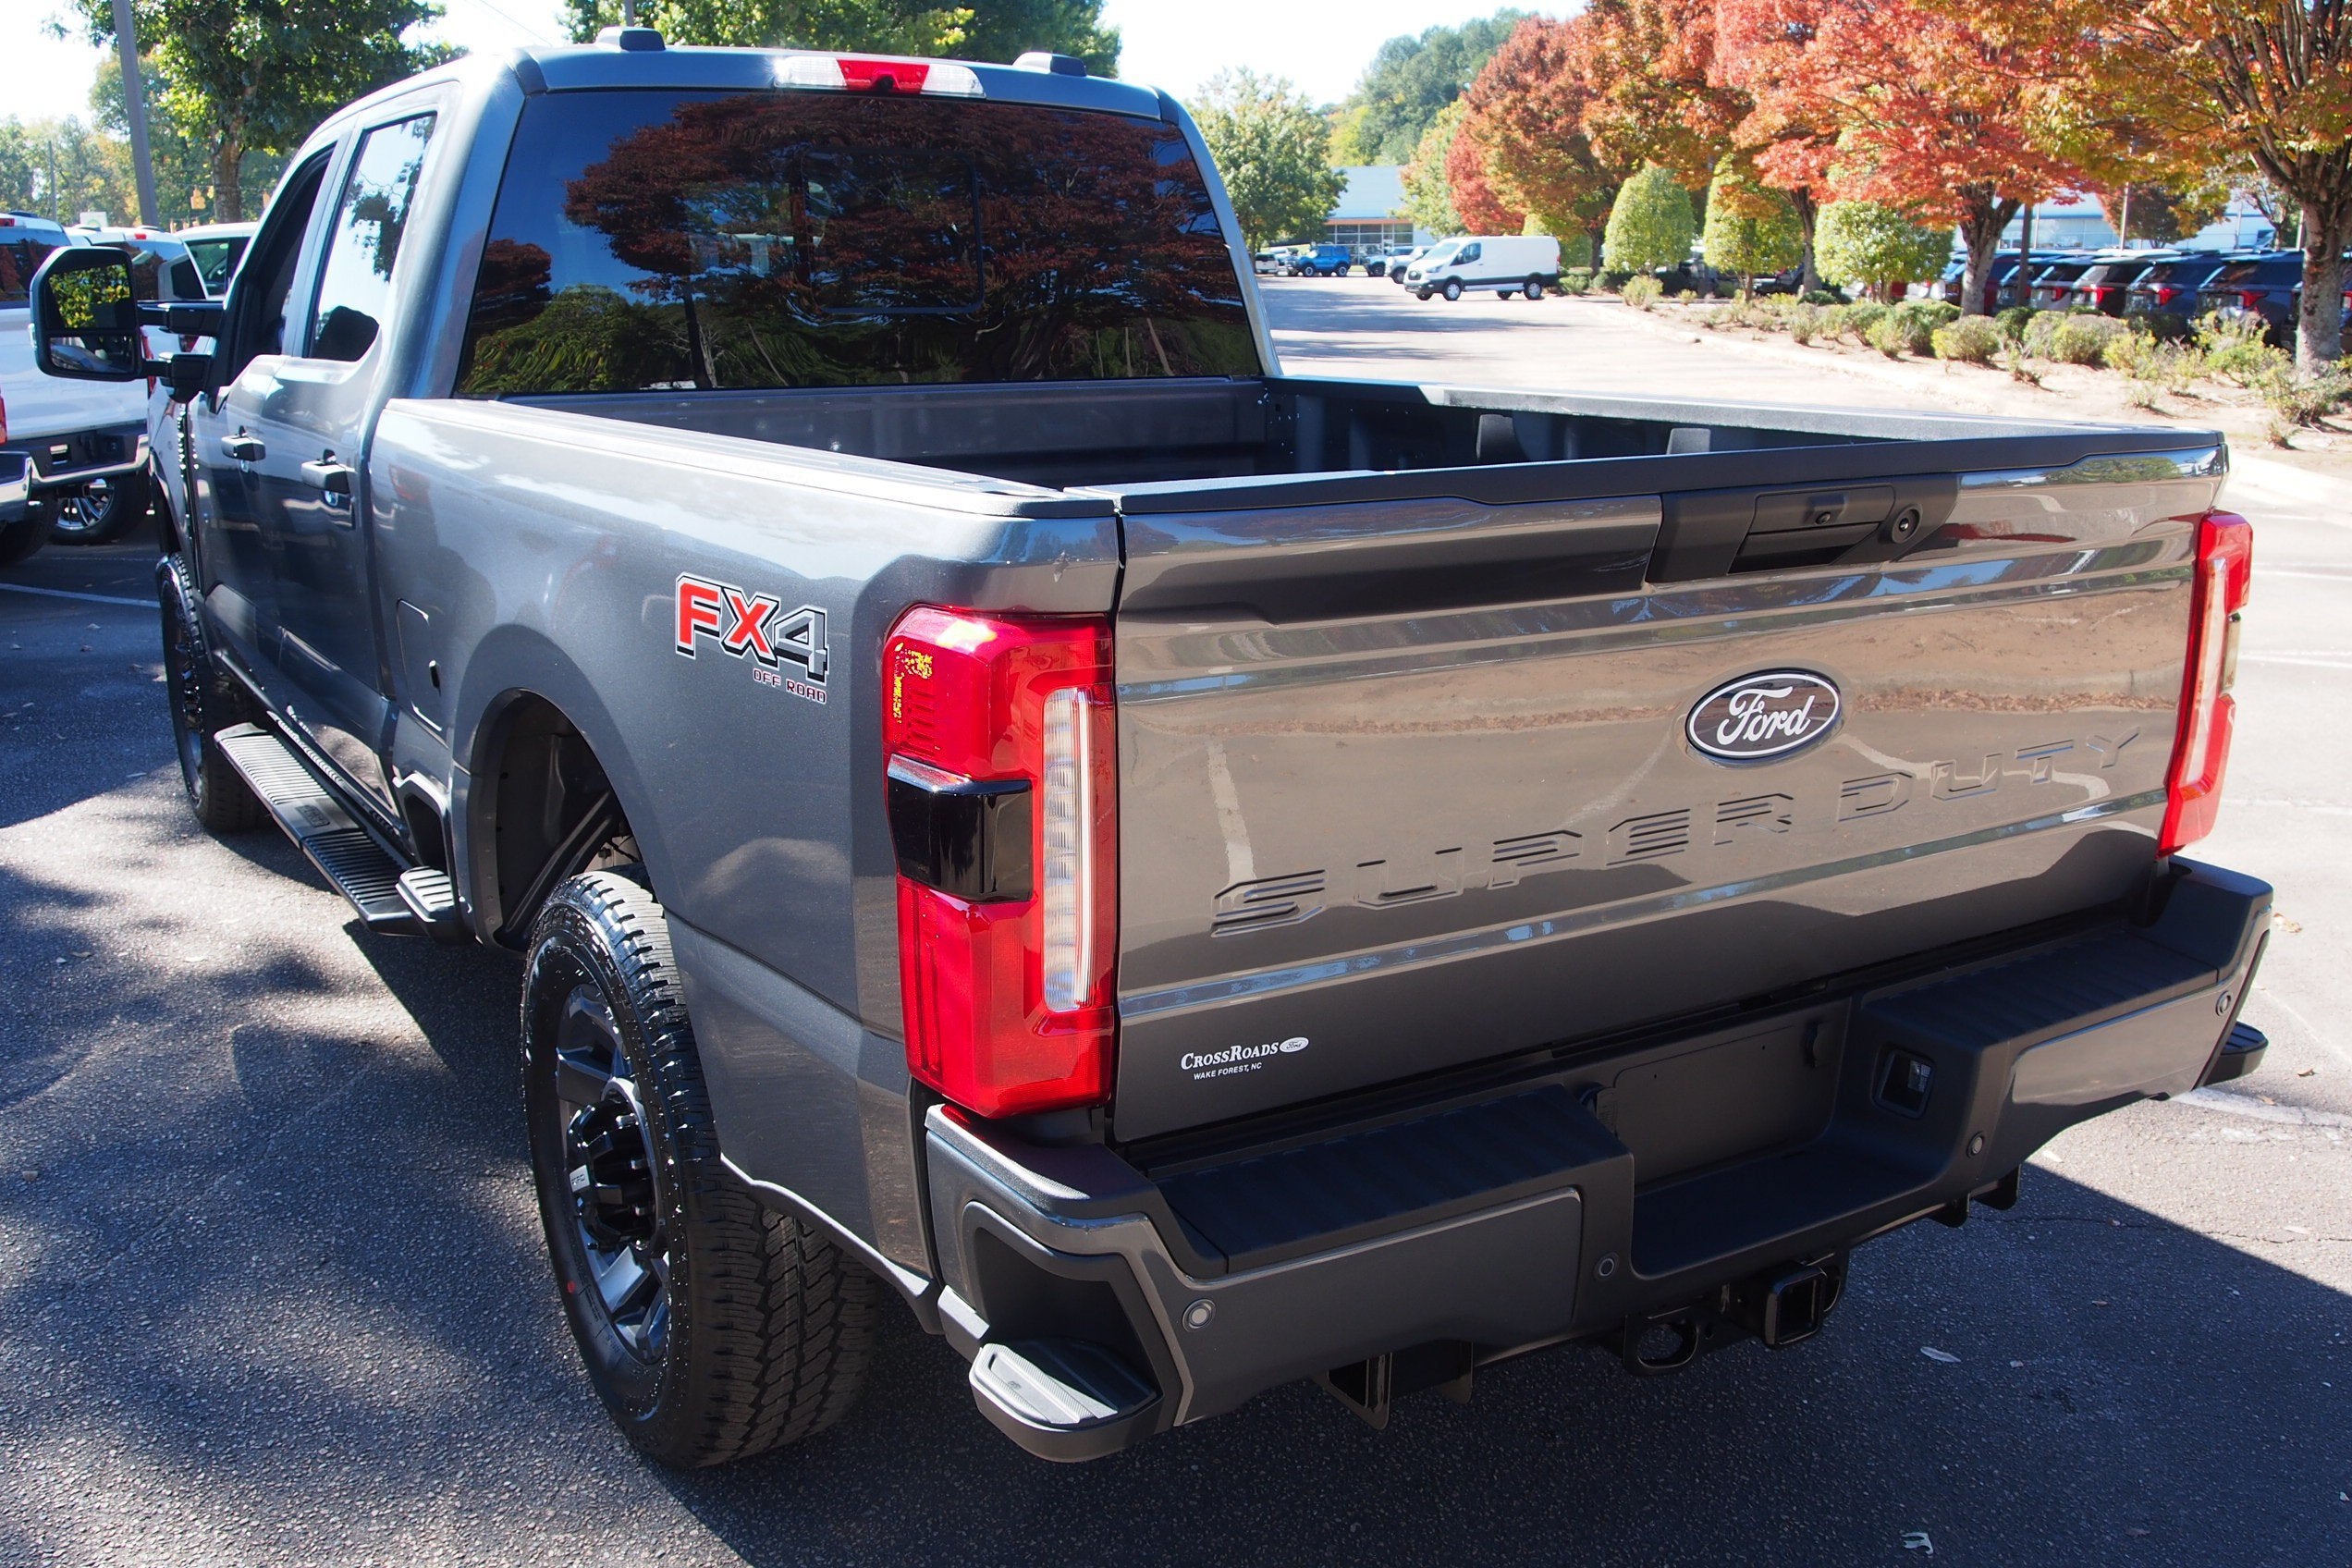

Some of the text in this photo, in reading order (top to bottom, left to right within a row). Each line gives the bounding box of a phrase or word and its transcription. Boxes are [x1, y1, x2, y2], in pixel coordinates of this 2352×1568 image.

[676, 571, 829, 686] FX4
[753, 667, 827, 704] OFF ROAD
[1717, 686, 1816, 745] Ford
[1210, 726, 2141, 937] SUPER DUTY
[1194, 1061, 1263, 1080] WAKE FOREST, NC
